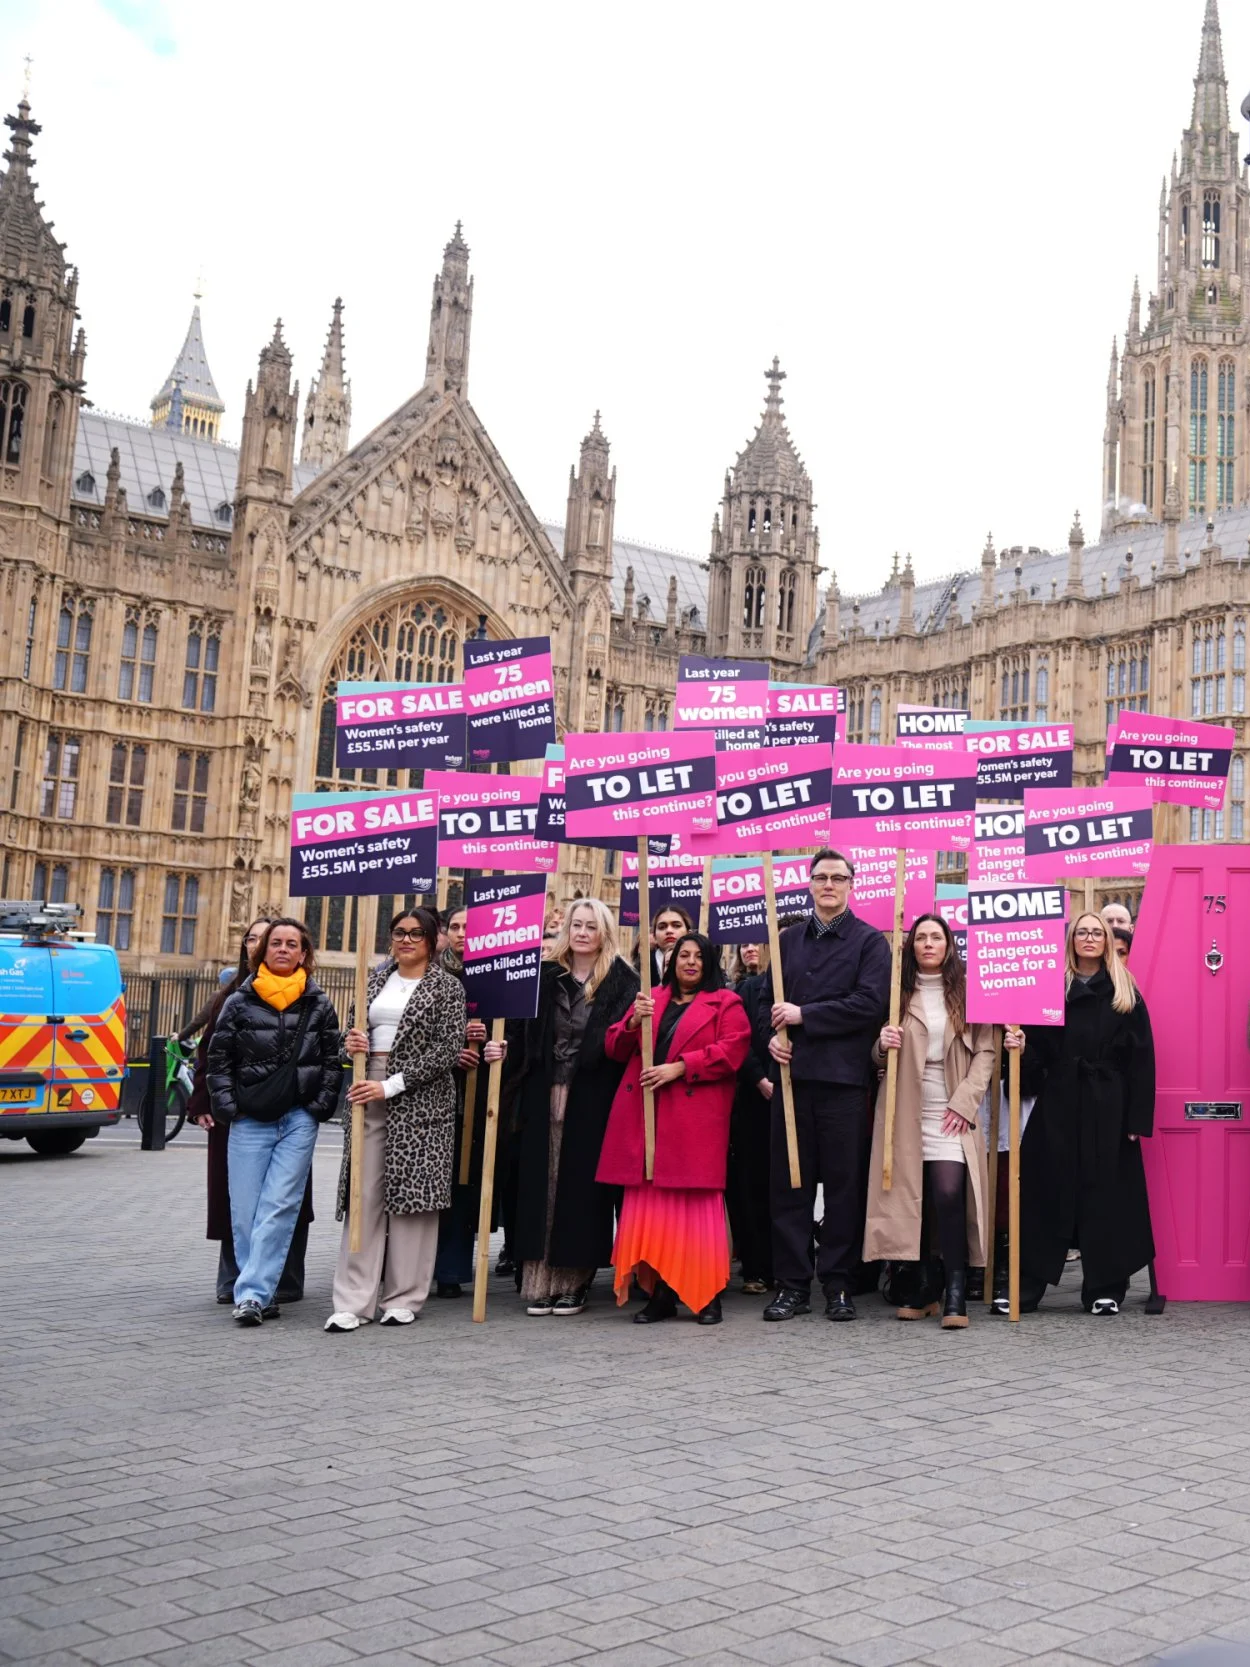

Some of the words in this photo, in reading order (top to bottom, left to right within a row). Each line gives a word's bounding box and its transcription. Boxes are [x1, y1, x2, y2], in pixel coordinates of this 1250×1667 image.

[470, 652, 494, 664] Last
[497, 647, 522, 661] year
[495, 664, 522, 684] 75
[469, 680, 550, 707] women
[342, 698, 394, 719] FOR
[402, 691, 463, 713] SALE
[471, 716, 501, 727] were
[503, 705, 535, 721] killed
[538, 703, 549, 713] at
[518, 716, 551, 729] home
[345, 725, 402, 739] Women's
[405, 722, 443, 733] safety
[1119, 730, 1139, 740] Are
[1142, 734, 1162, 742] you
[1165, 733, 1198, 745] going
[348, 739, 395, 753] £55.5M
[398, 739, 418, 750] per
[416, 734, 449, 747] year
[570, 758, 594, 769] Are
[598, 755, 624, 768] you
[628, 748, 670, 764] going
[1130, 750, 1162, 768] TO
[1170, 752, 1212, 771] LET
[837, 768, 861, 778] Are
[865, 768, 890, 779] you
[894, 763, 934, 778] going
[587, 776, 630, 801] TO
[639, 766, 692, 794] LET
[1145, 777, 1165, 786] this
[1168, 779, 1223, 789] continue?
[853, 788, 894, 811] TO
[903, 784, 954, 808] LET
[613, 807, 639, 820] this
[643, 795, 712, 816] continue?
[1029, 810, 1049, 819] Are
[1053, 807, 1075, 818] you
[1078, 801, 1113, 815] going
[297, 811, 355, 838] FOR
[364, 799, 434, 828] SALE
[876, 820, 901, 832] this
[904, 815, 971, 830] continue?
[1043, 825, 1080, 847] TO
[1087, 817, 1133, 841] LET
[300, 843, 364, 861] Women's
[368, 838, 410, 852] safety
[1065, 853, 1087, 864] this
[1090, 843, 1150, 860] continue?
[303, 860, 355, 878] £55.5M
[359, 861, 377, 873] per
[386, 854, 417, 869] year
[474, 889, 494, 902] Last
[497, 885, 520, 899] year
[971, 891, 1062, 919] HOME
[1204, 896, 1227, 913] 75
[493, 905, 517, 927] 75
[468, 925, 539, 952] women
[975, 931, 1003, 943] The
[1007, 928, 1043, 941] most
[978, 944, 1057, 959] dangerous
[9, 968, 24, 976] Gas
[465, 960, 492, 976] were
[494, 954, 523, 970] killed
[525, 953, 536, 964] at
[980, 961, 1019, 977] place
[1023, 958, 1044, 970] for
[1048, 959, 1056, 968] a
[507, 968, 536, 981] home
[980, 976, 1035, 989] woman
[10, 1089, 31, 1099] XTJ
